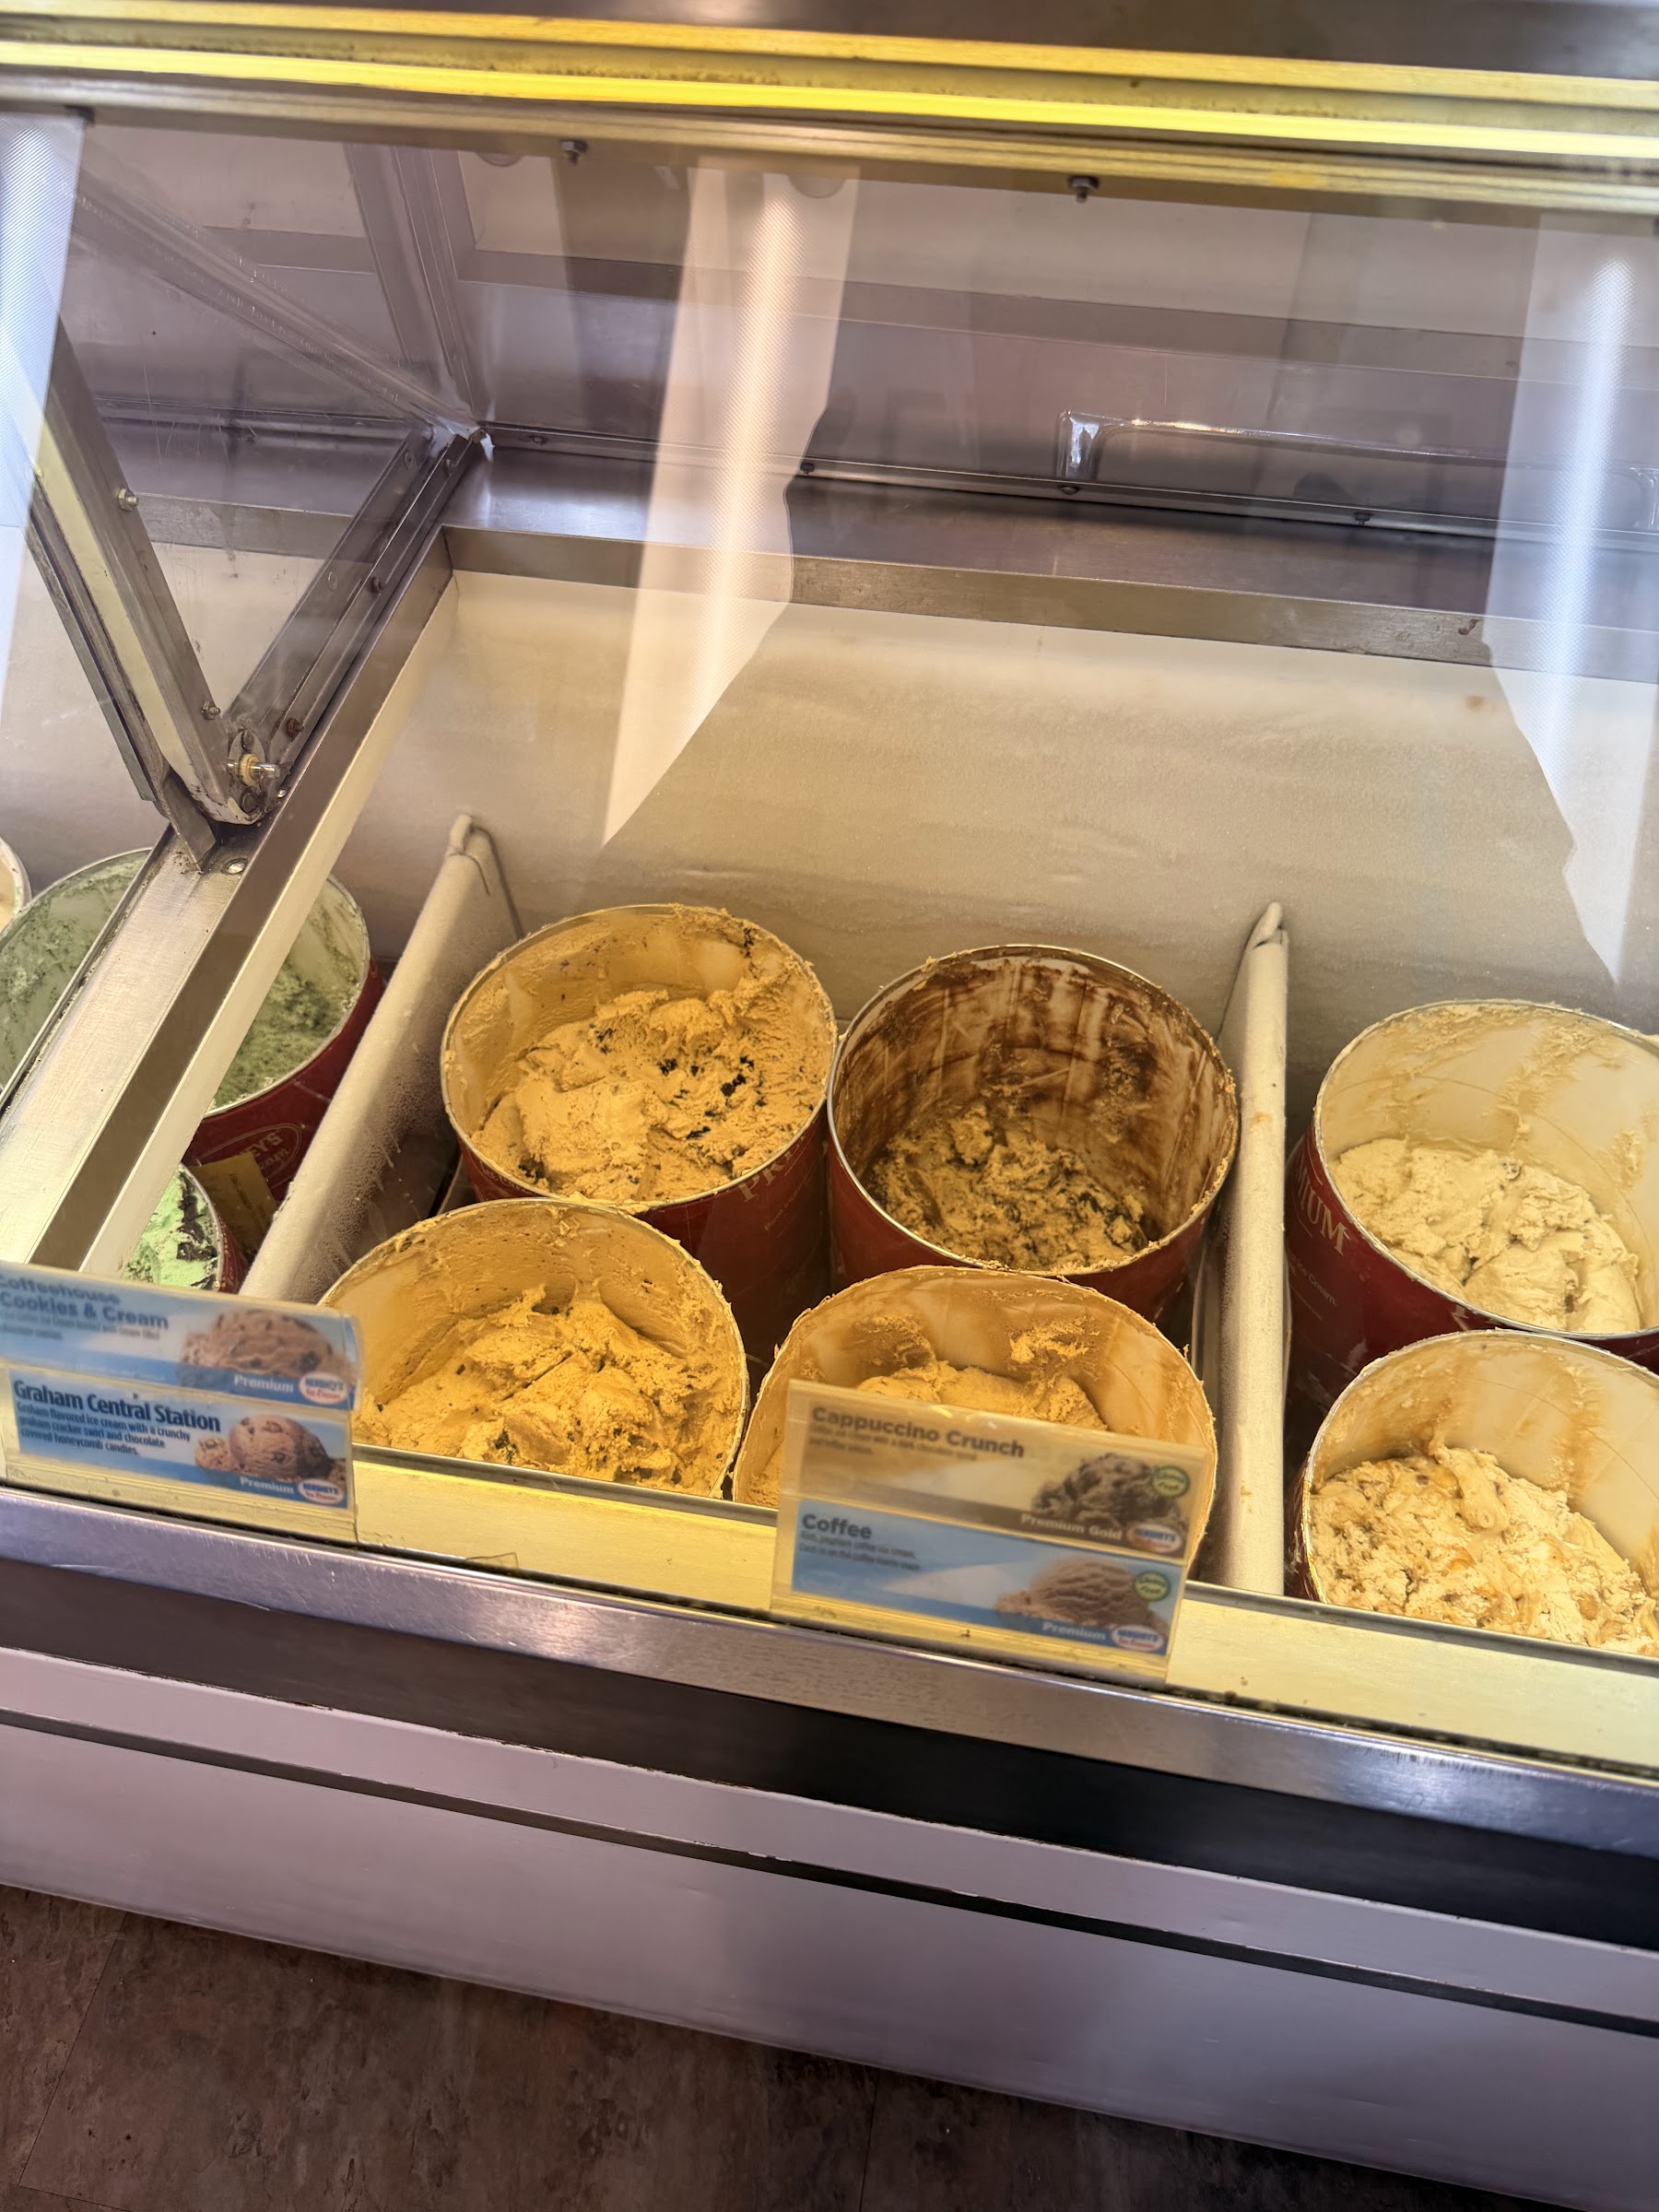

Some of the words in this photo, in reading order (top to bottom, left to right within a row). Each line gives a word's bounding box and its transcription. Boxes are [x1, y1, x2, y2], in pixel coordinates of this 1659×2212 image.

[1, 1292, 77, 1316] Cookies
[84, 1302, 96, 1319] &
[102, 1306, 169, 1329] Cream
[233, 1373, 294, 1393] Premium
[14, 1380, 84, 1410] Graham
[87, 1394, 151, 1421] Central
[154, 1405, 221, 1432] Station
[50, 1408, 86, 1423] flavored
[86, 1414, 99, 1425] ice
[100, 1418, 127, 1430] cream
[128, 1421, 149, 1434] with
[157, 1428, 191, 1442] crunchy
[52, 1422, 82, 1434] cracker
[84, 1426, 105, 1438] swirl
[106, 1430, 123, 1441] and
[124, 1433, 165, 1448] chocolate
[812, 1406, 939, 1442] Cappuccino
[946, 1430, 1025, 1457] Crunch
[54, 1432, 103, 1451] honeycomb
[240, 1477, 295, 1494] Premium
[803, 1513, 872, 1539] Coffee
[1020, 1512, 1085, 1534] Premium
[1088, 1524, 1124, 1541] Gold
[1042, 1620, 1107, 1641] Premium
